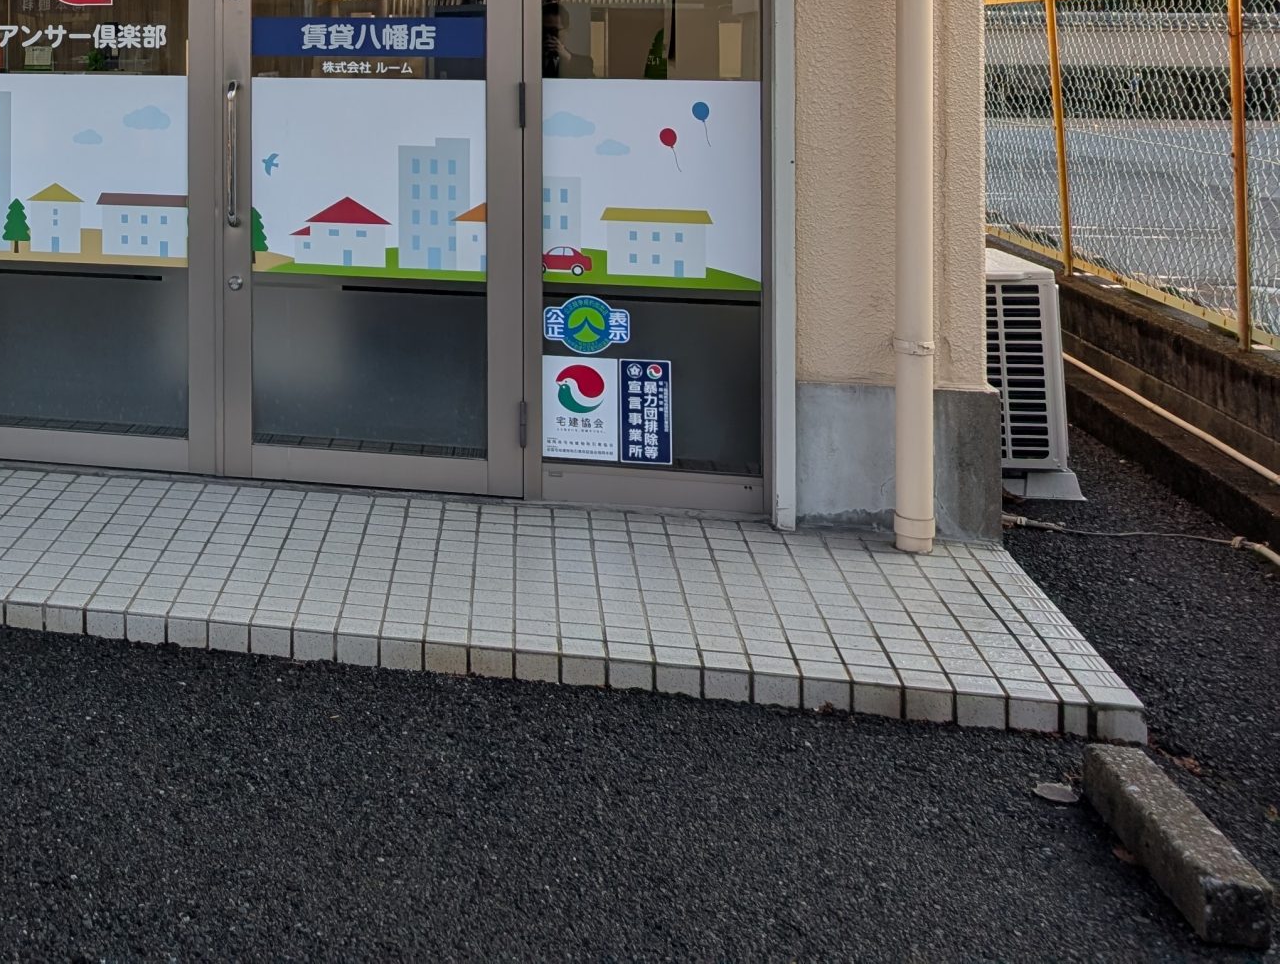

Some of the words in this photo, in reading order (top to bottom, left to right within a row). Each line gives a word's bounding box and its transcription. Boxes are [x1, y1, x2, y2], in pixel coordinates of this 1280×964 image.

[301, 23, 436, 50] 賃貸八幡店
[322, 61, 371, 74] 株式会社
[376, 62, 413, 74] ルーム
[546, 309, 565, 338] 公正
[608, 312, 627, 340] 表示
[556, 416, 604, 429] 宅建協会
[627, 380, 642, 458] 宣言事業所
[644, 381, 658, 459] 暴力団排除等
